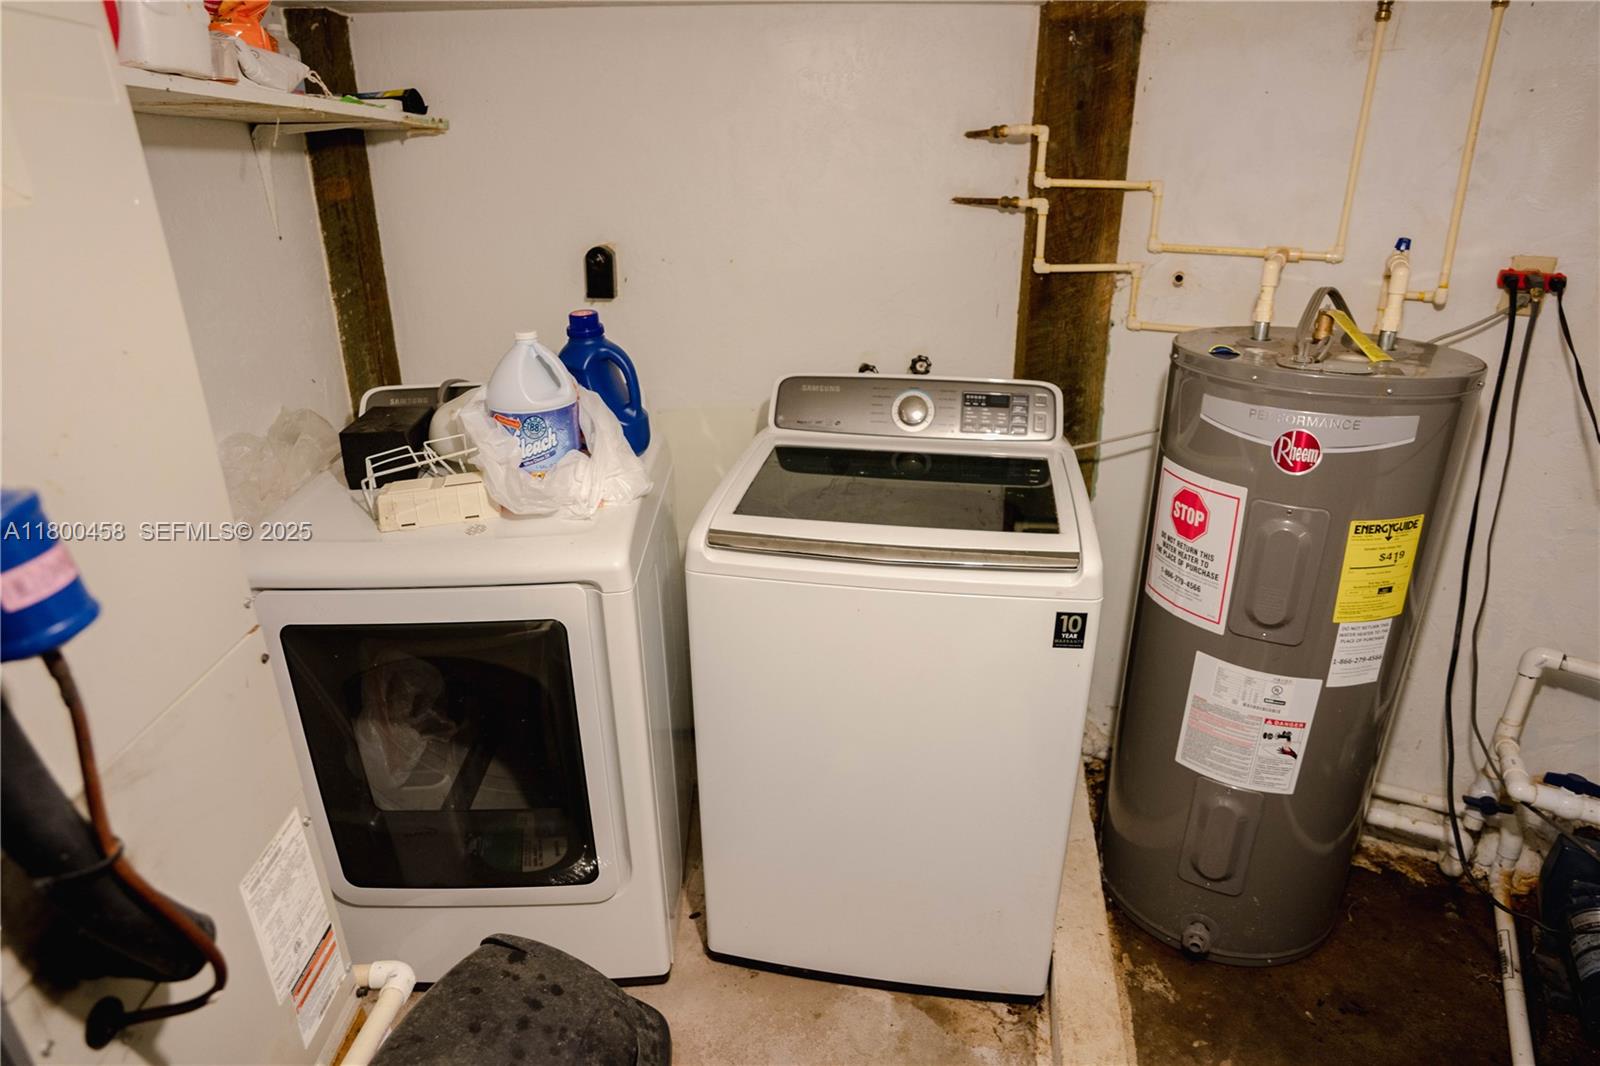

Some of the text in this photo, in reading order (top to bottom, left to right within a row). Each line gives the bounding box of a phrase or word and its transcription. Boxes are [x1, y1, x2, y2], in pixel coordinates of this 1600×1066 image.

[801, 384, 840, 392] SAMSUNG
[1249, 408, 1361, 430] PERFORMANCE
[1276, 430, 1319, 467] Rheem
[1173, 501, 1205, 527] STOP
[1161, 530, 1215, 562] DO NOT RETURN THIS
[1162, 540, 1209, 569] WATER HEATER TO
[1162, 548, 1177, 564] PLACE
[1177, 558, 1184, 566] OF
[1185, 562, 1219, 581] PURCHASE
[1060, 614, 1083, 633] 10
[1274, 720, 1305, 728] DANGER
